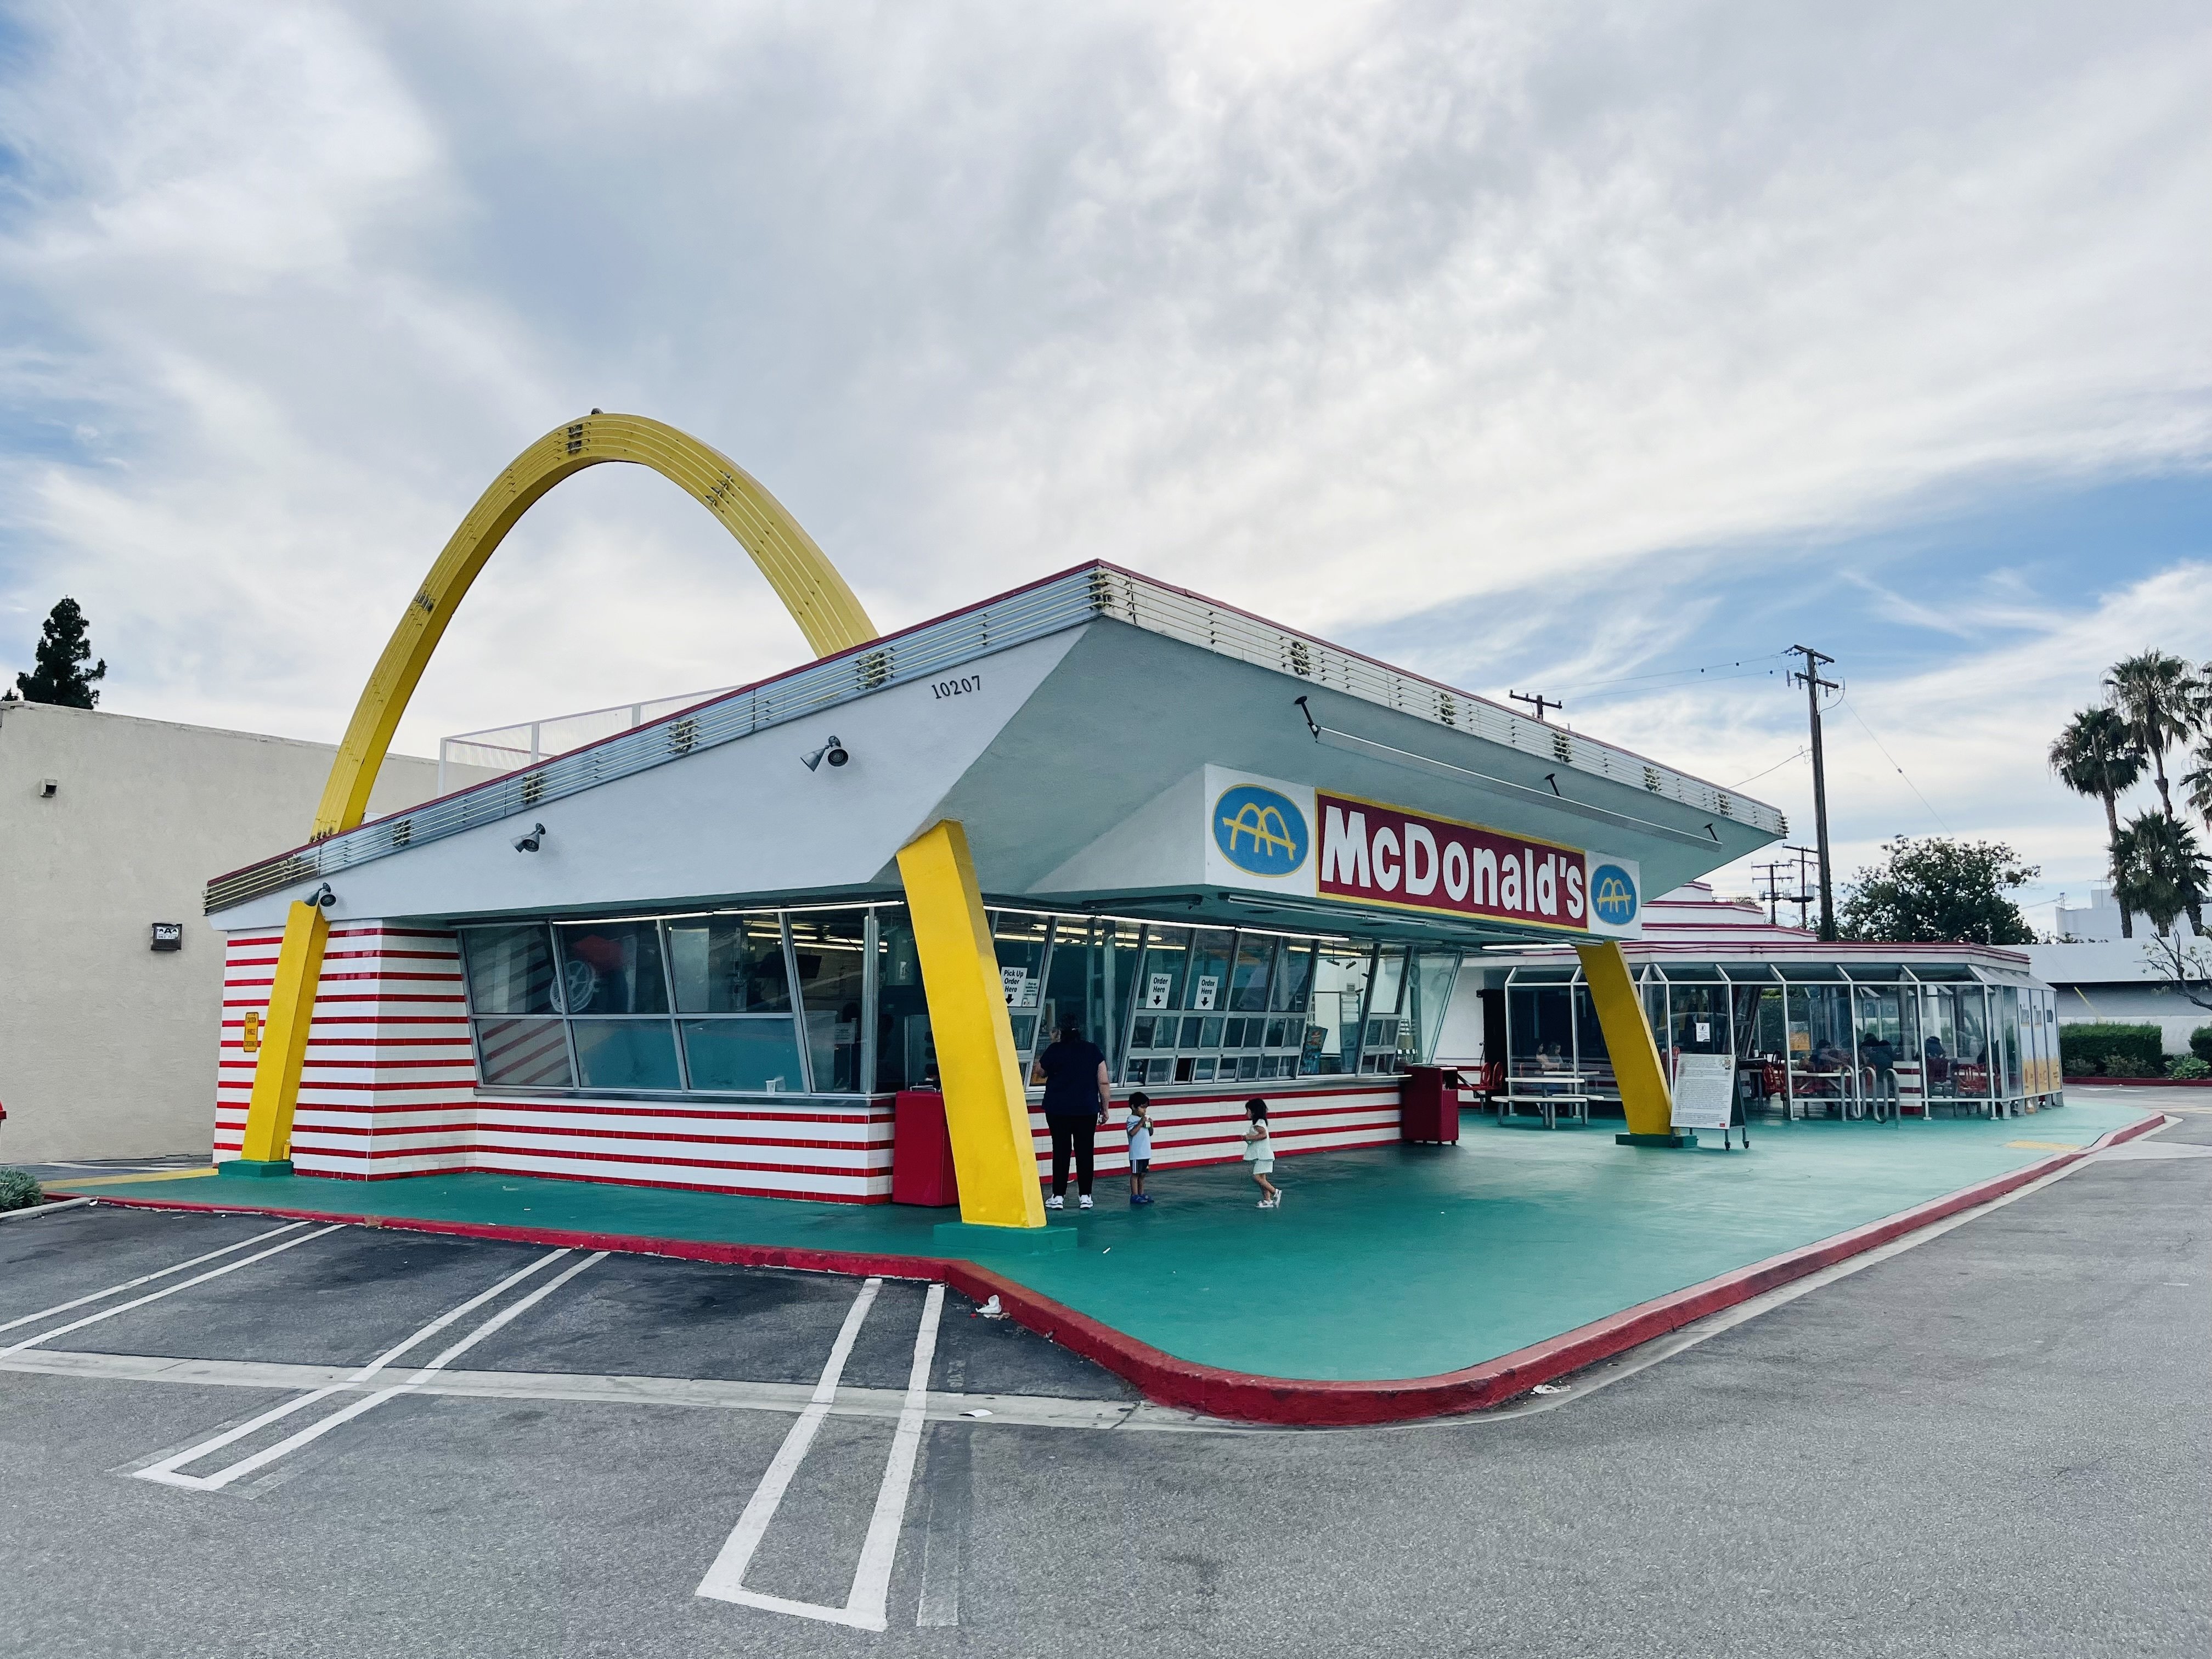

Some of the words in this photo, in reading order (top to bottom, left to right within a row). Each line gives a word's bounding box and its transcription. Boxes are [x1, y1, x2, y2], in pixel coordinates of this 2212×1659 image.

[931, 675, 980, 699] 10207
[1321, 805, 1584, 919] McDonald's
[1016, 970, 1024, 979] Up
